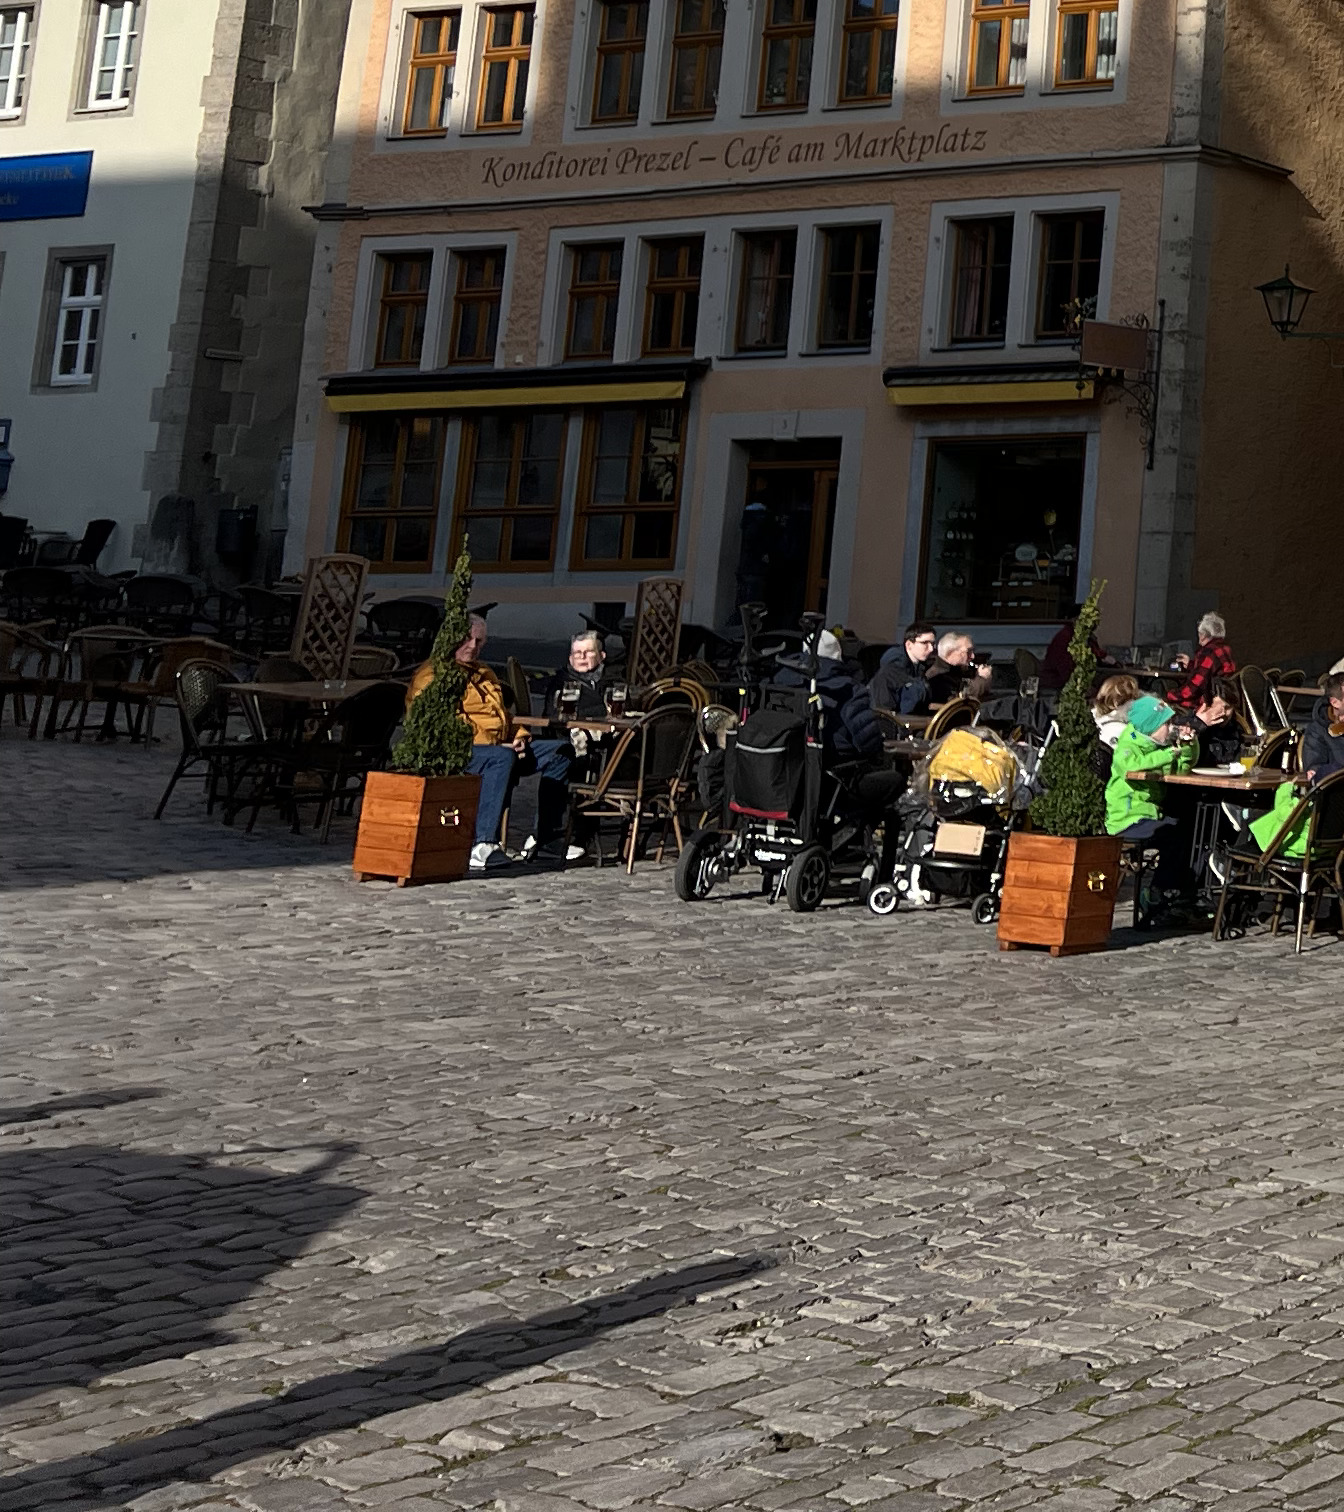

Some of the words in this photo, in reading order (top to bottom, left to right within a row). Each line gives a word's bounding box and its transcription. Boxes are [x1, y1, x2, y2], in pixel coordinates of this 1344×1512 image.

[481, 148, 611, 188] Konditorei
[616, 141, 698, 175] Prezel
[724, 134, 783, 173] Café
[787, 141, 825, 163] am
[834, 123, 988, 164] Marktplatz
